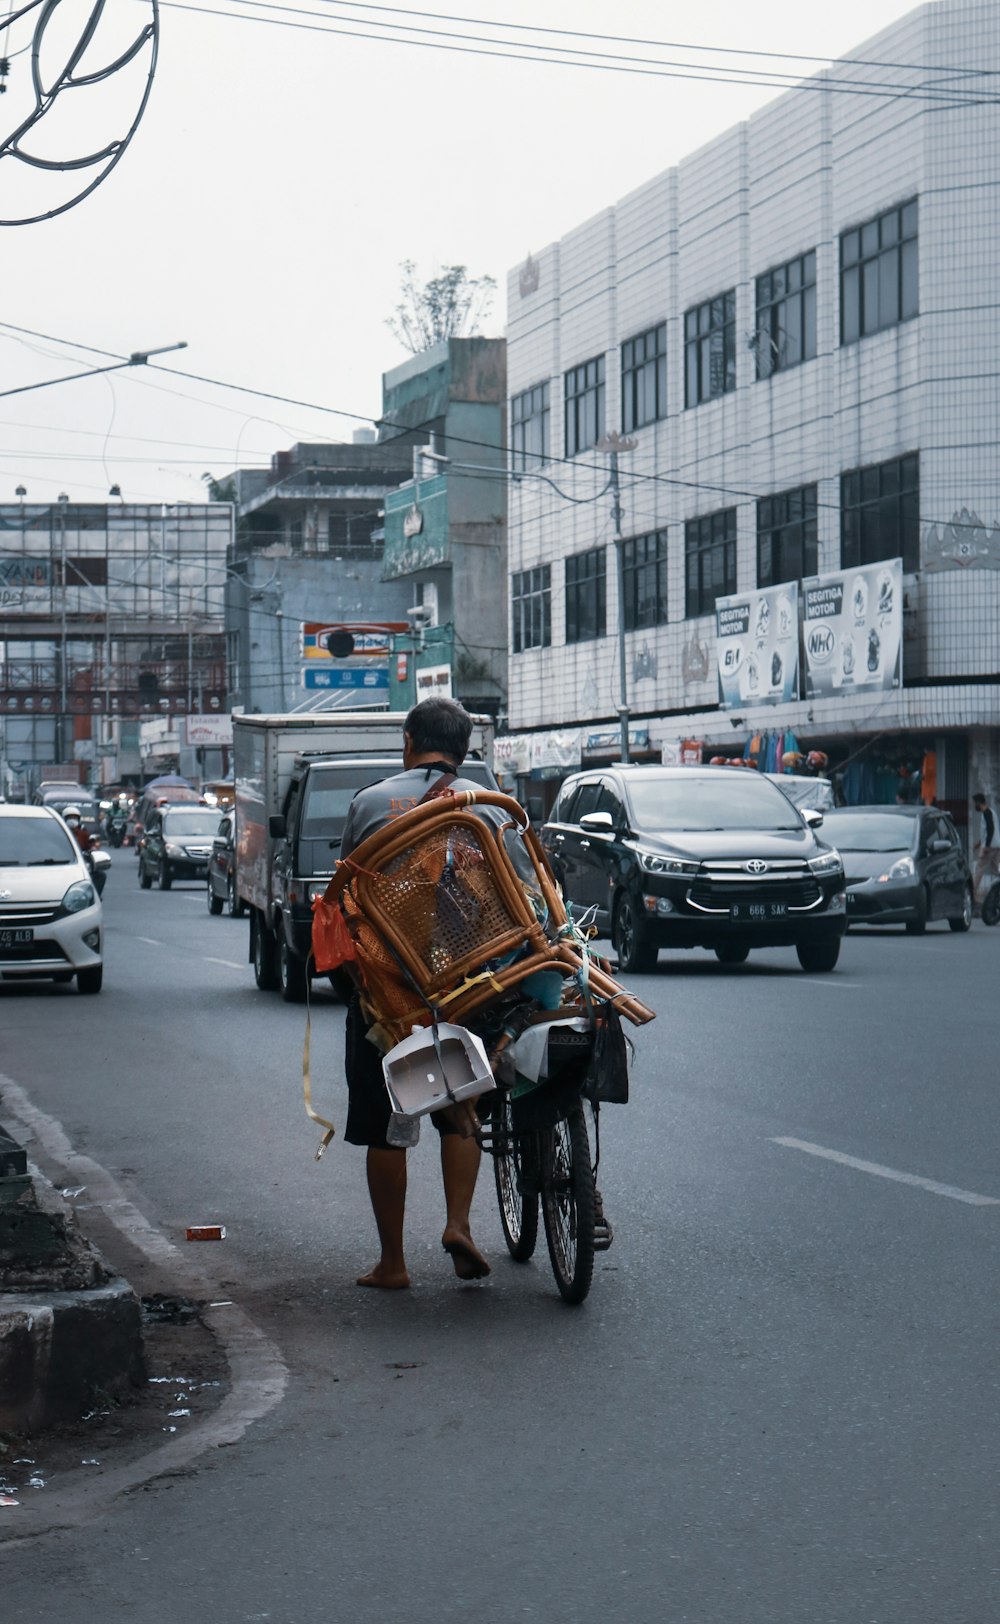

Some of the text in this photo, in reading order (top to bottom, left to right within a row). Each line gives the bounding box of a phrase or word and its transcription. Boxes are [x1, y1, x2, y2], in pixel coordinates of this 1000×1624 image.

[807, 587, 843, 604] SEGITIGA
[720, 607, 750, 621] SEGITIGA
[807, 602, 836, 618] MOTOR
[720, 621, 744, 634] MOTOR
[809, 632, 834, 654] NHK
[733, 904, 787, 917] B 666 SAK
[14, 930, 31, 942] ALB
